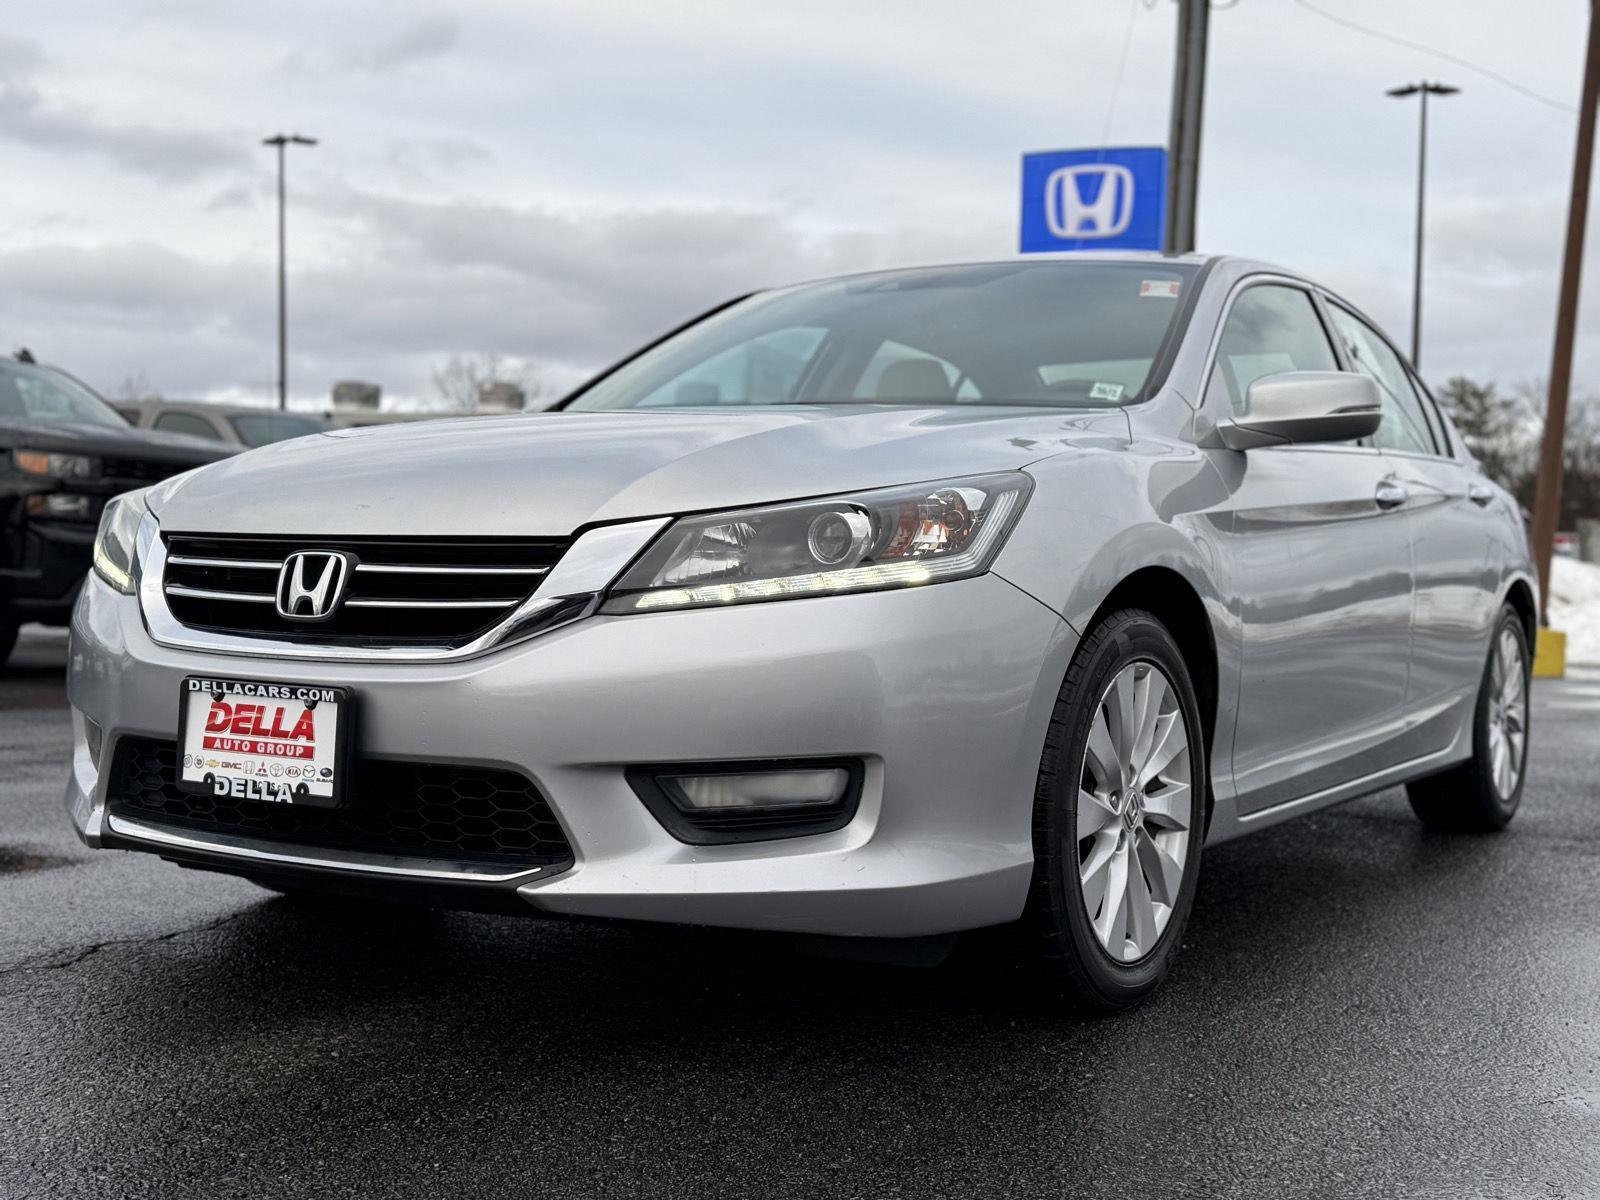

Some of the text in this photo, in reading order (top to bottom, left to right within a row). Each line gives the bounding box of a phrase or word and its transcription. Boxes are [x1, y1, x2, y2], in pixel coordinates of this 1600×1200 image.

[189, 679, 335, 702] DELLACARS.COM
[205, 700, 316, 742] DELLA
[213, 738, 304, 757] AUTO GROUP
[221, 761, 242, 770] GMC
[287, 767, 300, 776] KIA
[214, 776, 293, 804] DELLA
